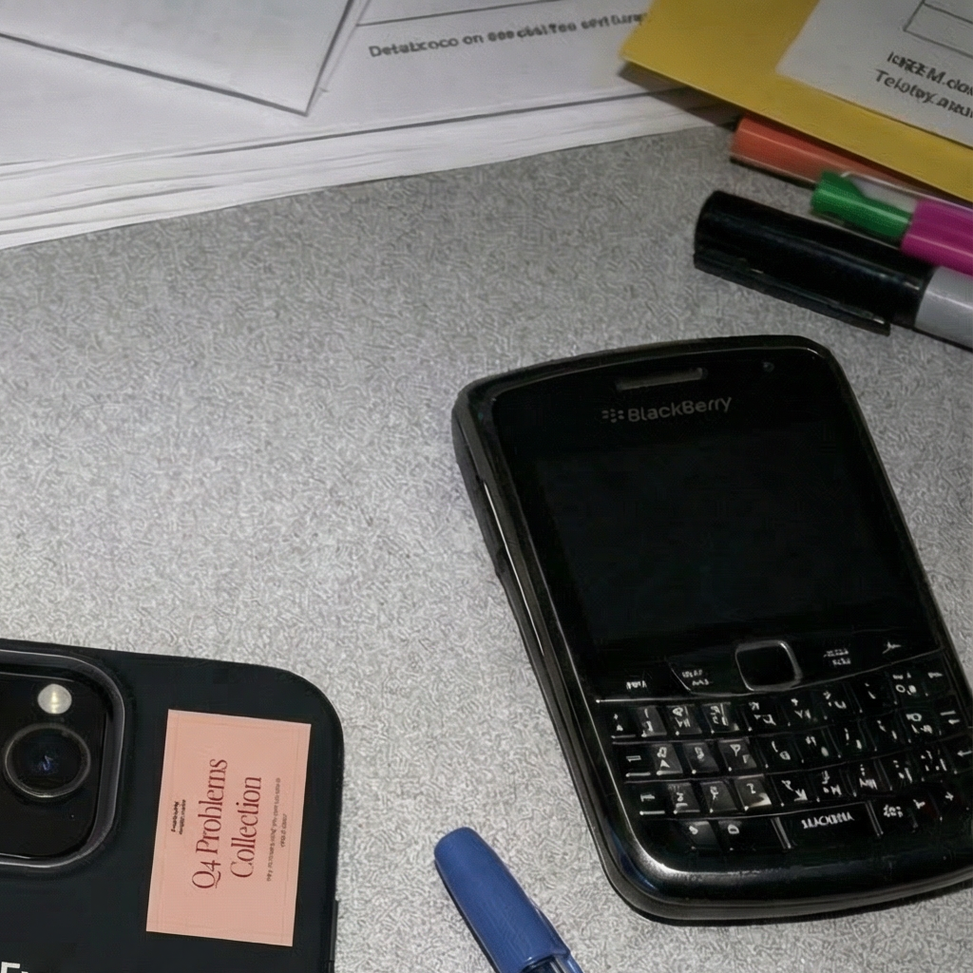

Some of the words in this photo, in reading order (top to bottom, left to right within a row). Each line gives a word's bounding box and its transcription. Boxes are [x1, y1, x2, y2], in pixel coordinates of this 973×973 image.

[628, 396, 732, 423] BlackBerry
[230, 776, 262, 879] Collection
[191, 860, 221, 889] Q4
